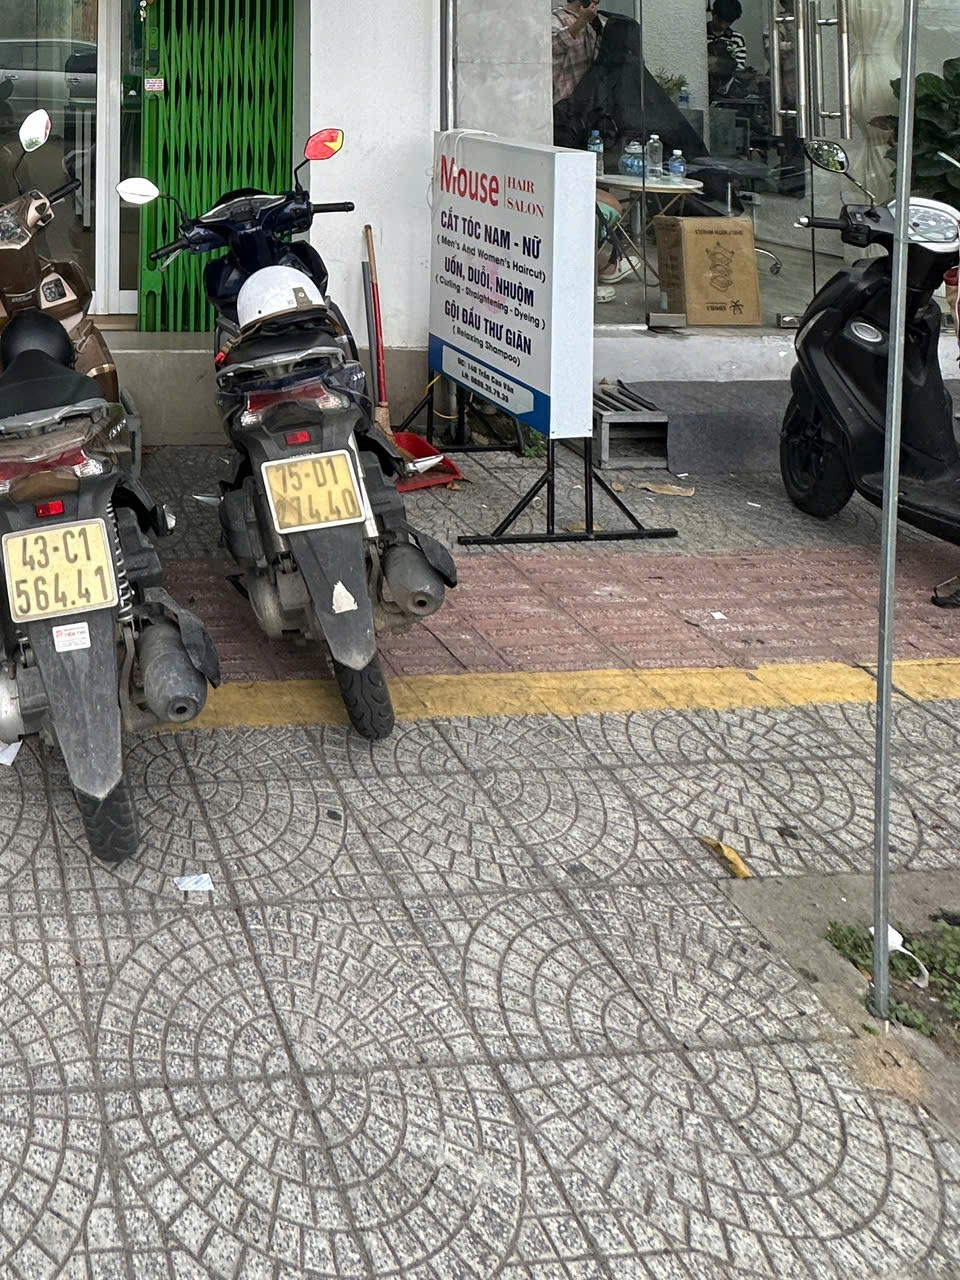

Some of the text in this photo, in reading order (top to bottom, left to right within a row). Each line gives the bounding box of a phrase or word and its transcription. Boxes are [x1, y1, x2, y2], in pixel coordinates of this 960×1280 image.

[440, 154, 500, 207] Mouse
[507, 176, 535, 194] HAIR
[506, 196, 545, 218] SALON
[440, 206, 459, 232] CẮT
[461, 215, 481, 240] TÓC
[484, 224, 511, 250] NAM
[522, 235, 542, 260] NỮ
[461, 244, 476, 257] And
[477, 248, 511, 269] Women's
[495, 276, 534, 307] NHUỘM
[444, 300, 460, 322] GỘI
[483, 318, 504, 342] THƯ
[505, 328, 532, 356] GIÃN
[275, 457, 339, 494] 75-D1
[21, 527, 92, 571] 43-C1
[15, 565, 109, 614] 564.41
